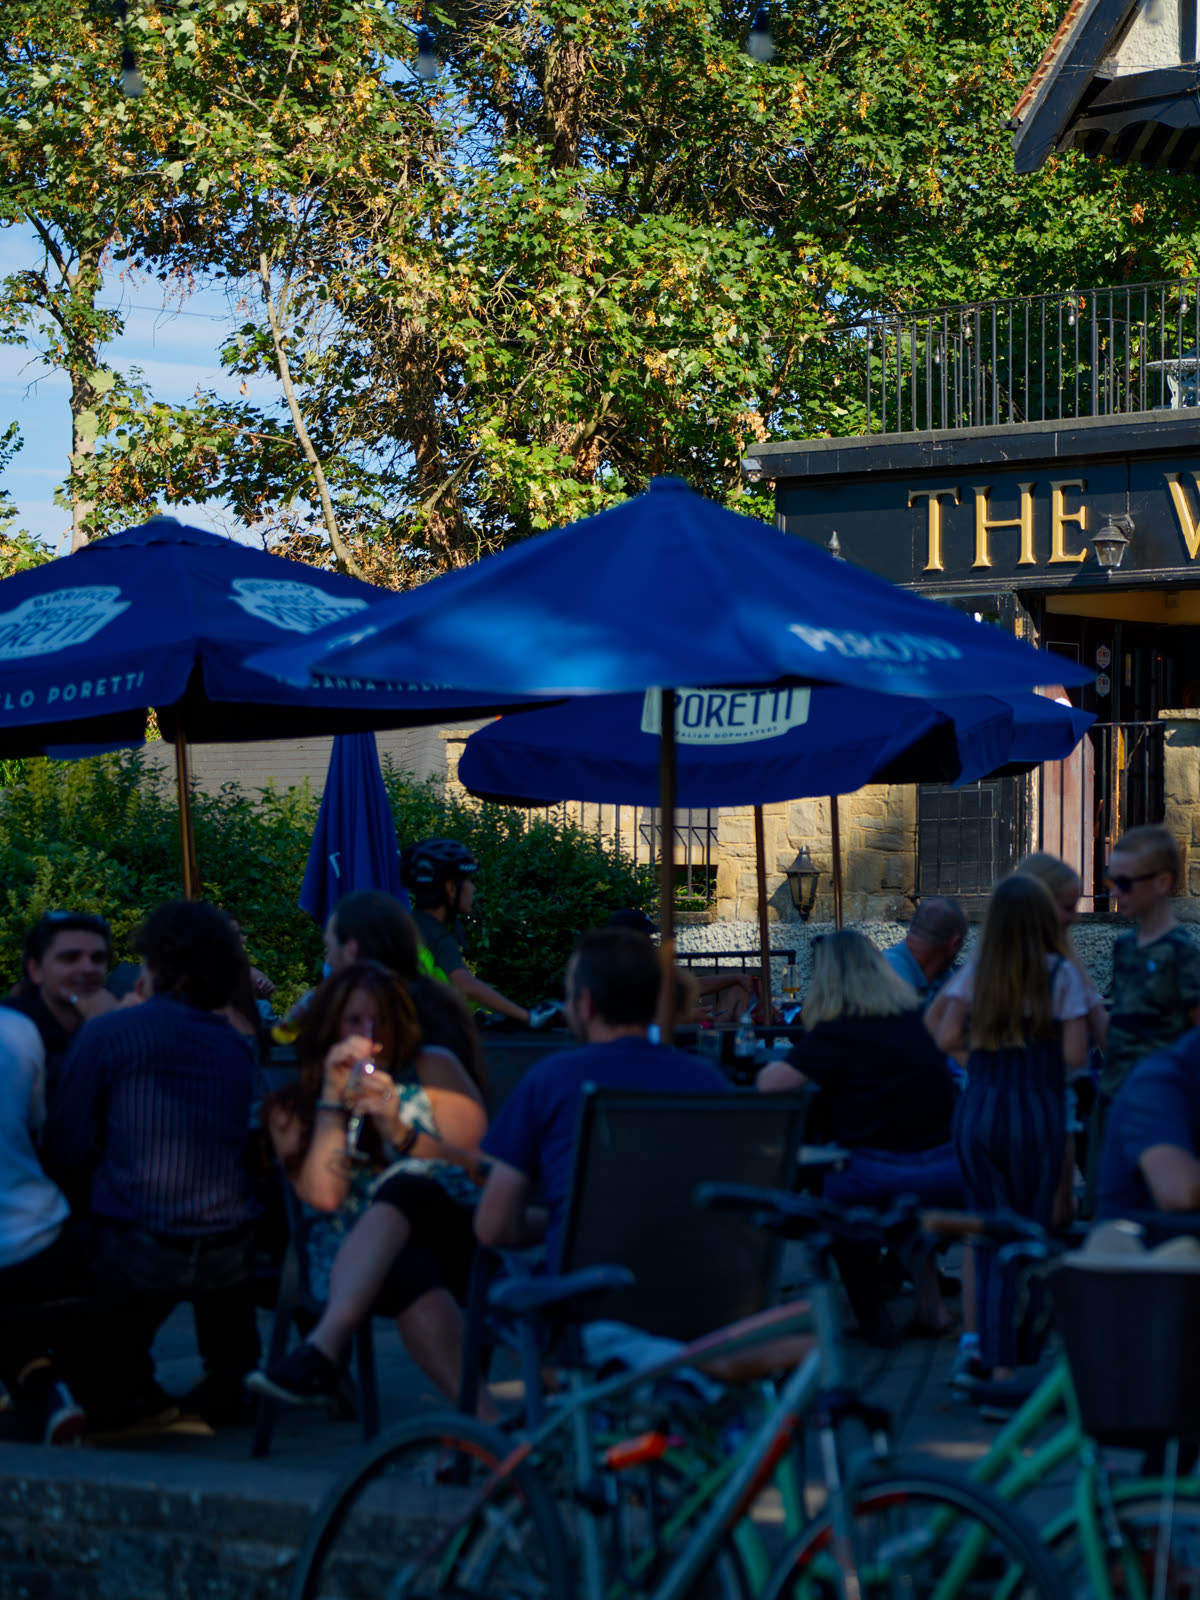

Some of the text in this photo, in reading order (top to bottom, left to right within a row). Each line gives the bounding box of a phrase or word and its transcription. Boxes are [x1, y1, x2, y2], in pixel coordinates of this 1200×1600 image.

[908, 477, 1088, 572] THE
[47, 670, 145, 704] PORETTI
[675, 730, 710, 740] TALIAN
